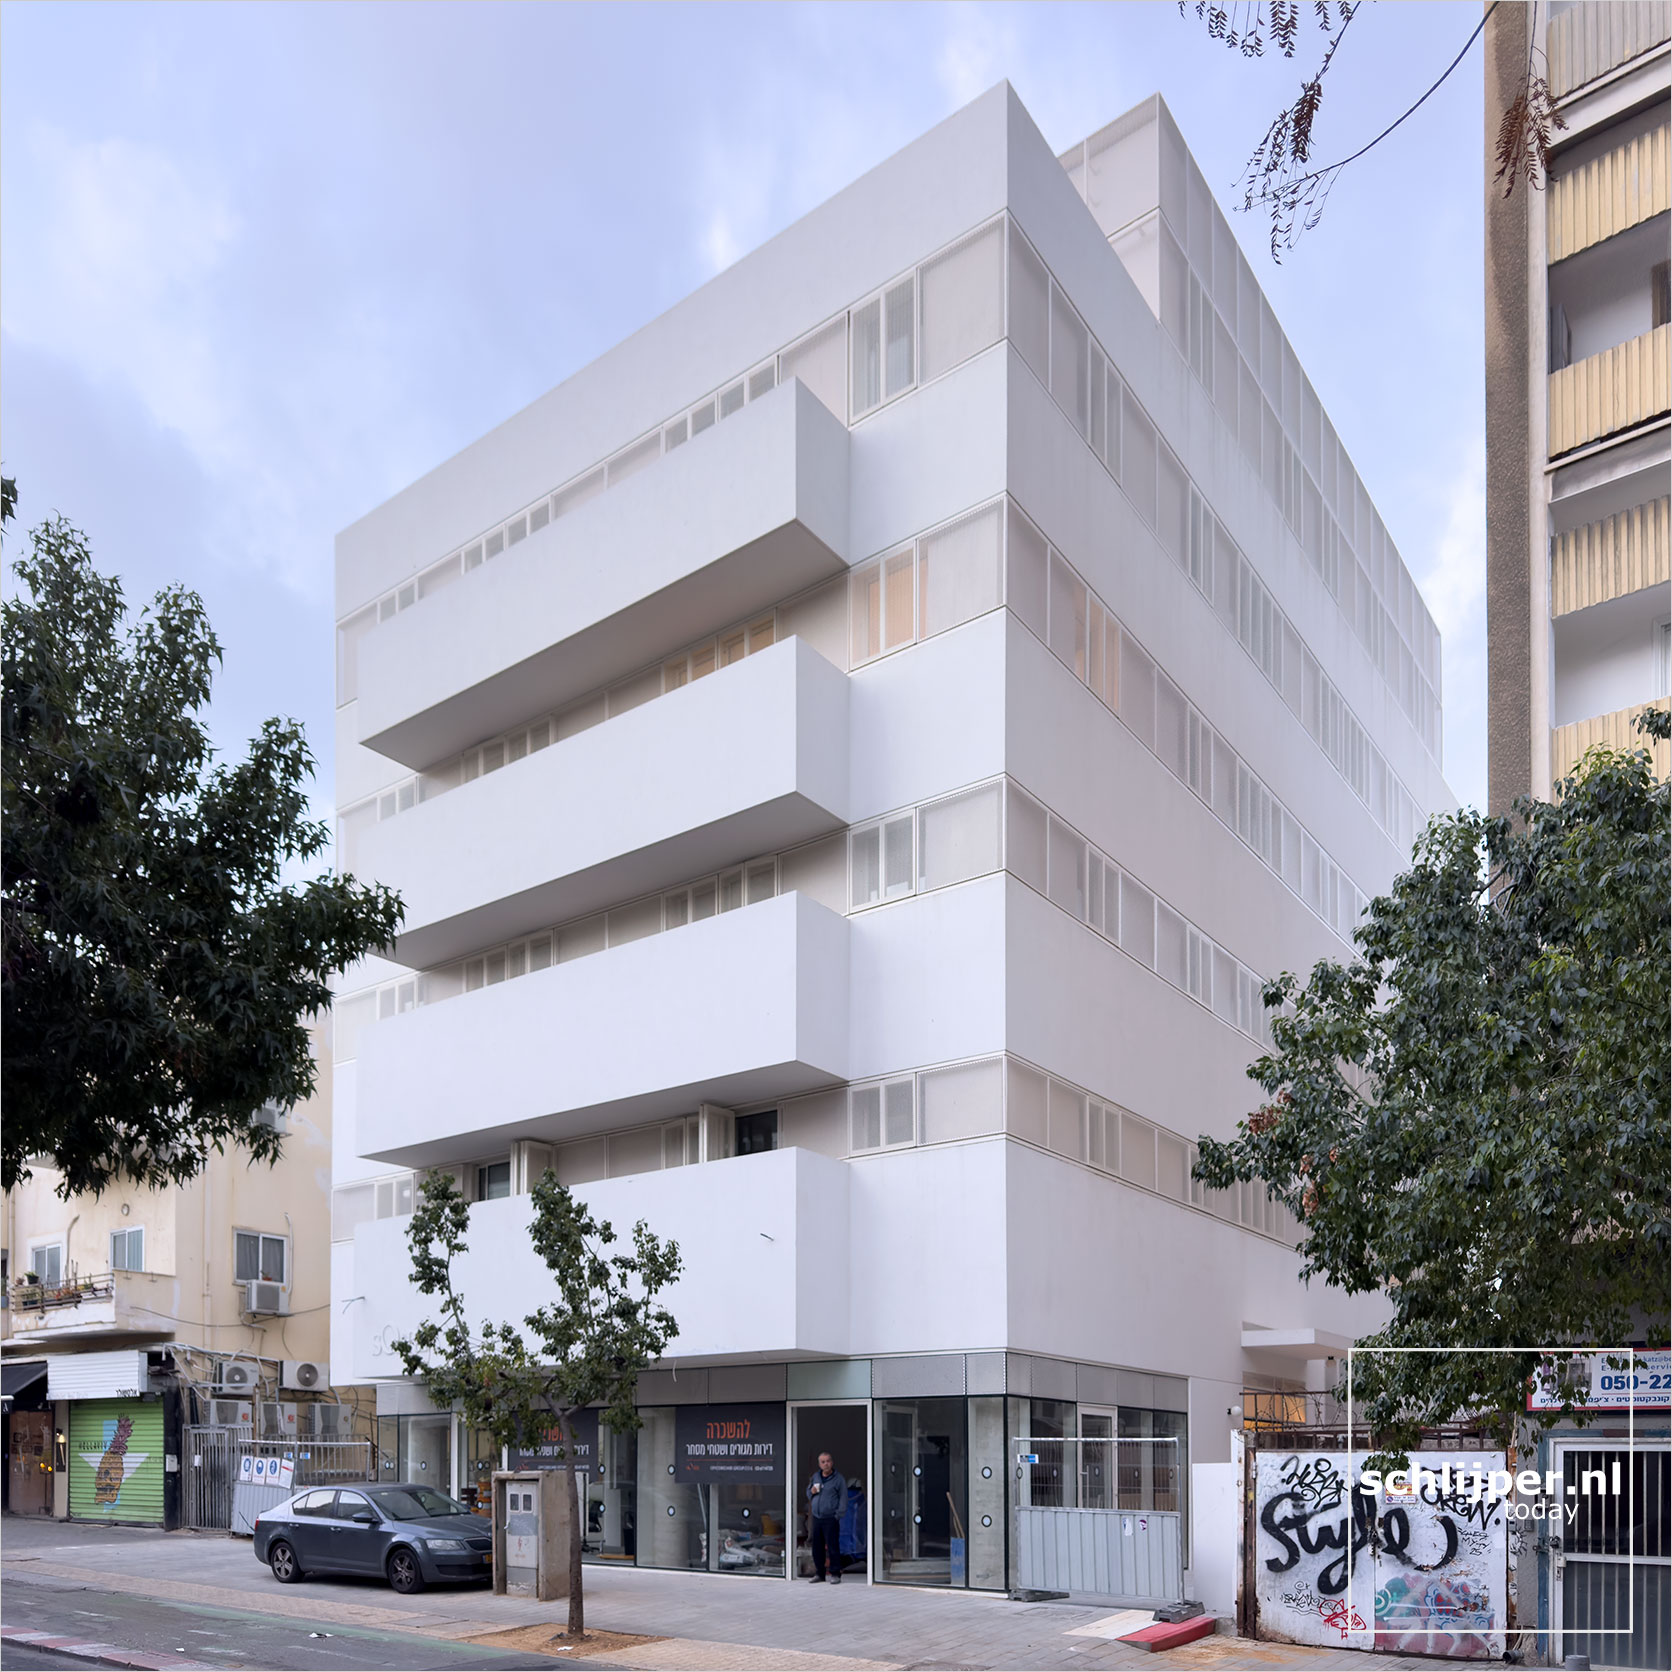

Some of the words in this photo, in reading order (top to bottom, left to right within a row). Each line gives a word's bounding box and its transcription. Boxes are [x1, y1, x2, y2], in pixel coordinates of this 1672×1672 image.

[706, 1418, 751, 1439] להשכרה
[686, 1444, 706, 1456] מסחר
[707, 1443, 728, 1455] ושטחי
[729, 1443, 752, 1455] מגורים
[753, 1443, 773, 1455] דירות
